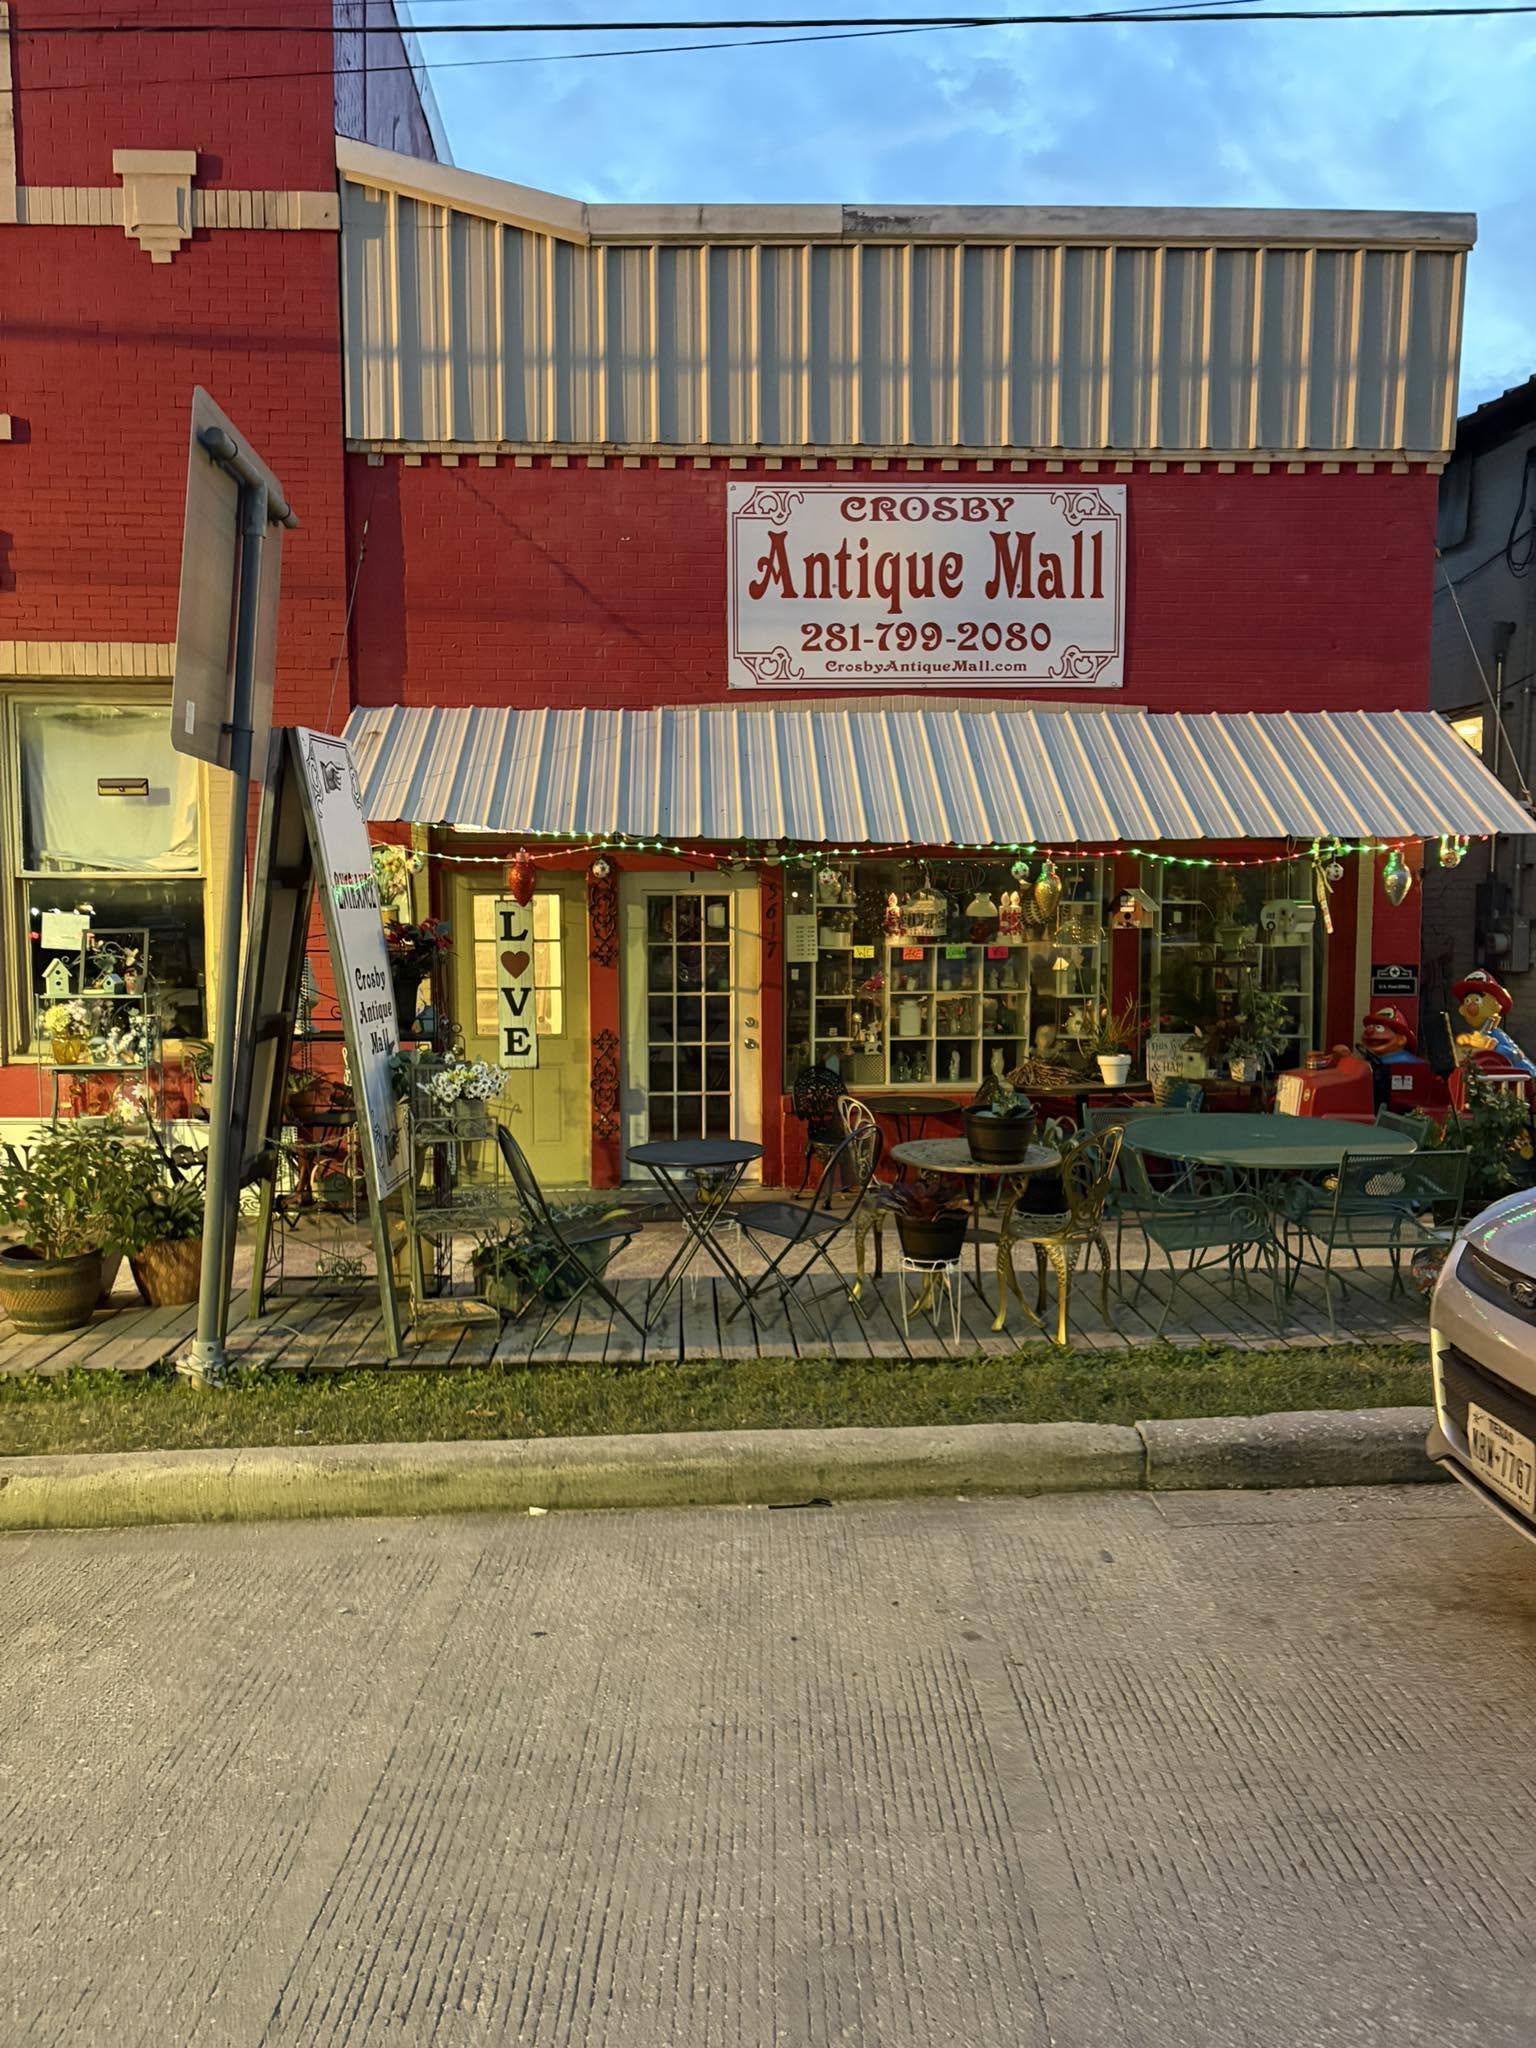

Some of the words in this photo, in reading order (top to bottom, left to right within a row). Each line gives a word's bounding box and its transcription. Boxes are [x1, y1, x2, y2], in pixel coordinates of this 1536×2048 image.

[841, 496, 1015, 522] CROSBY
[749, 530, 964, 614] Antique
[985, 530, 1105, 600] Mall
[800, 622, 1052, 652] 281-799-2080
[825, 660, 1028, 675] CrosbyAntiqueMall.com
[355, 965, 386, 991] Crosby
[360, 1000, 392, 1025] Antique
[371, 1027, 390, 1055] Mall
